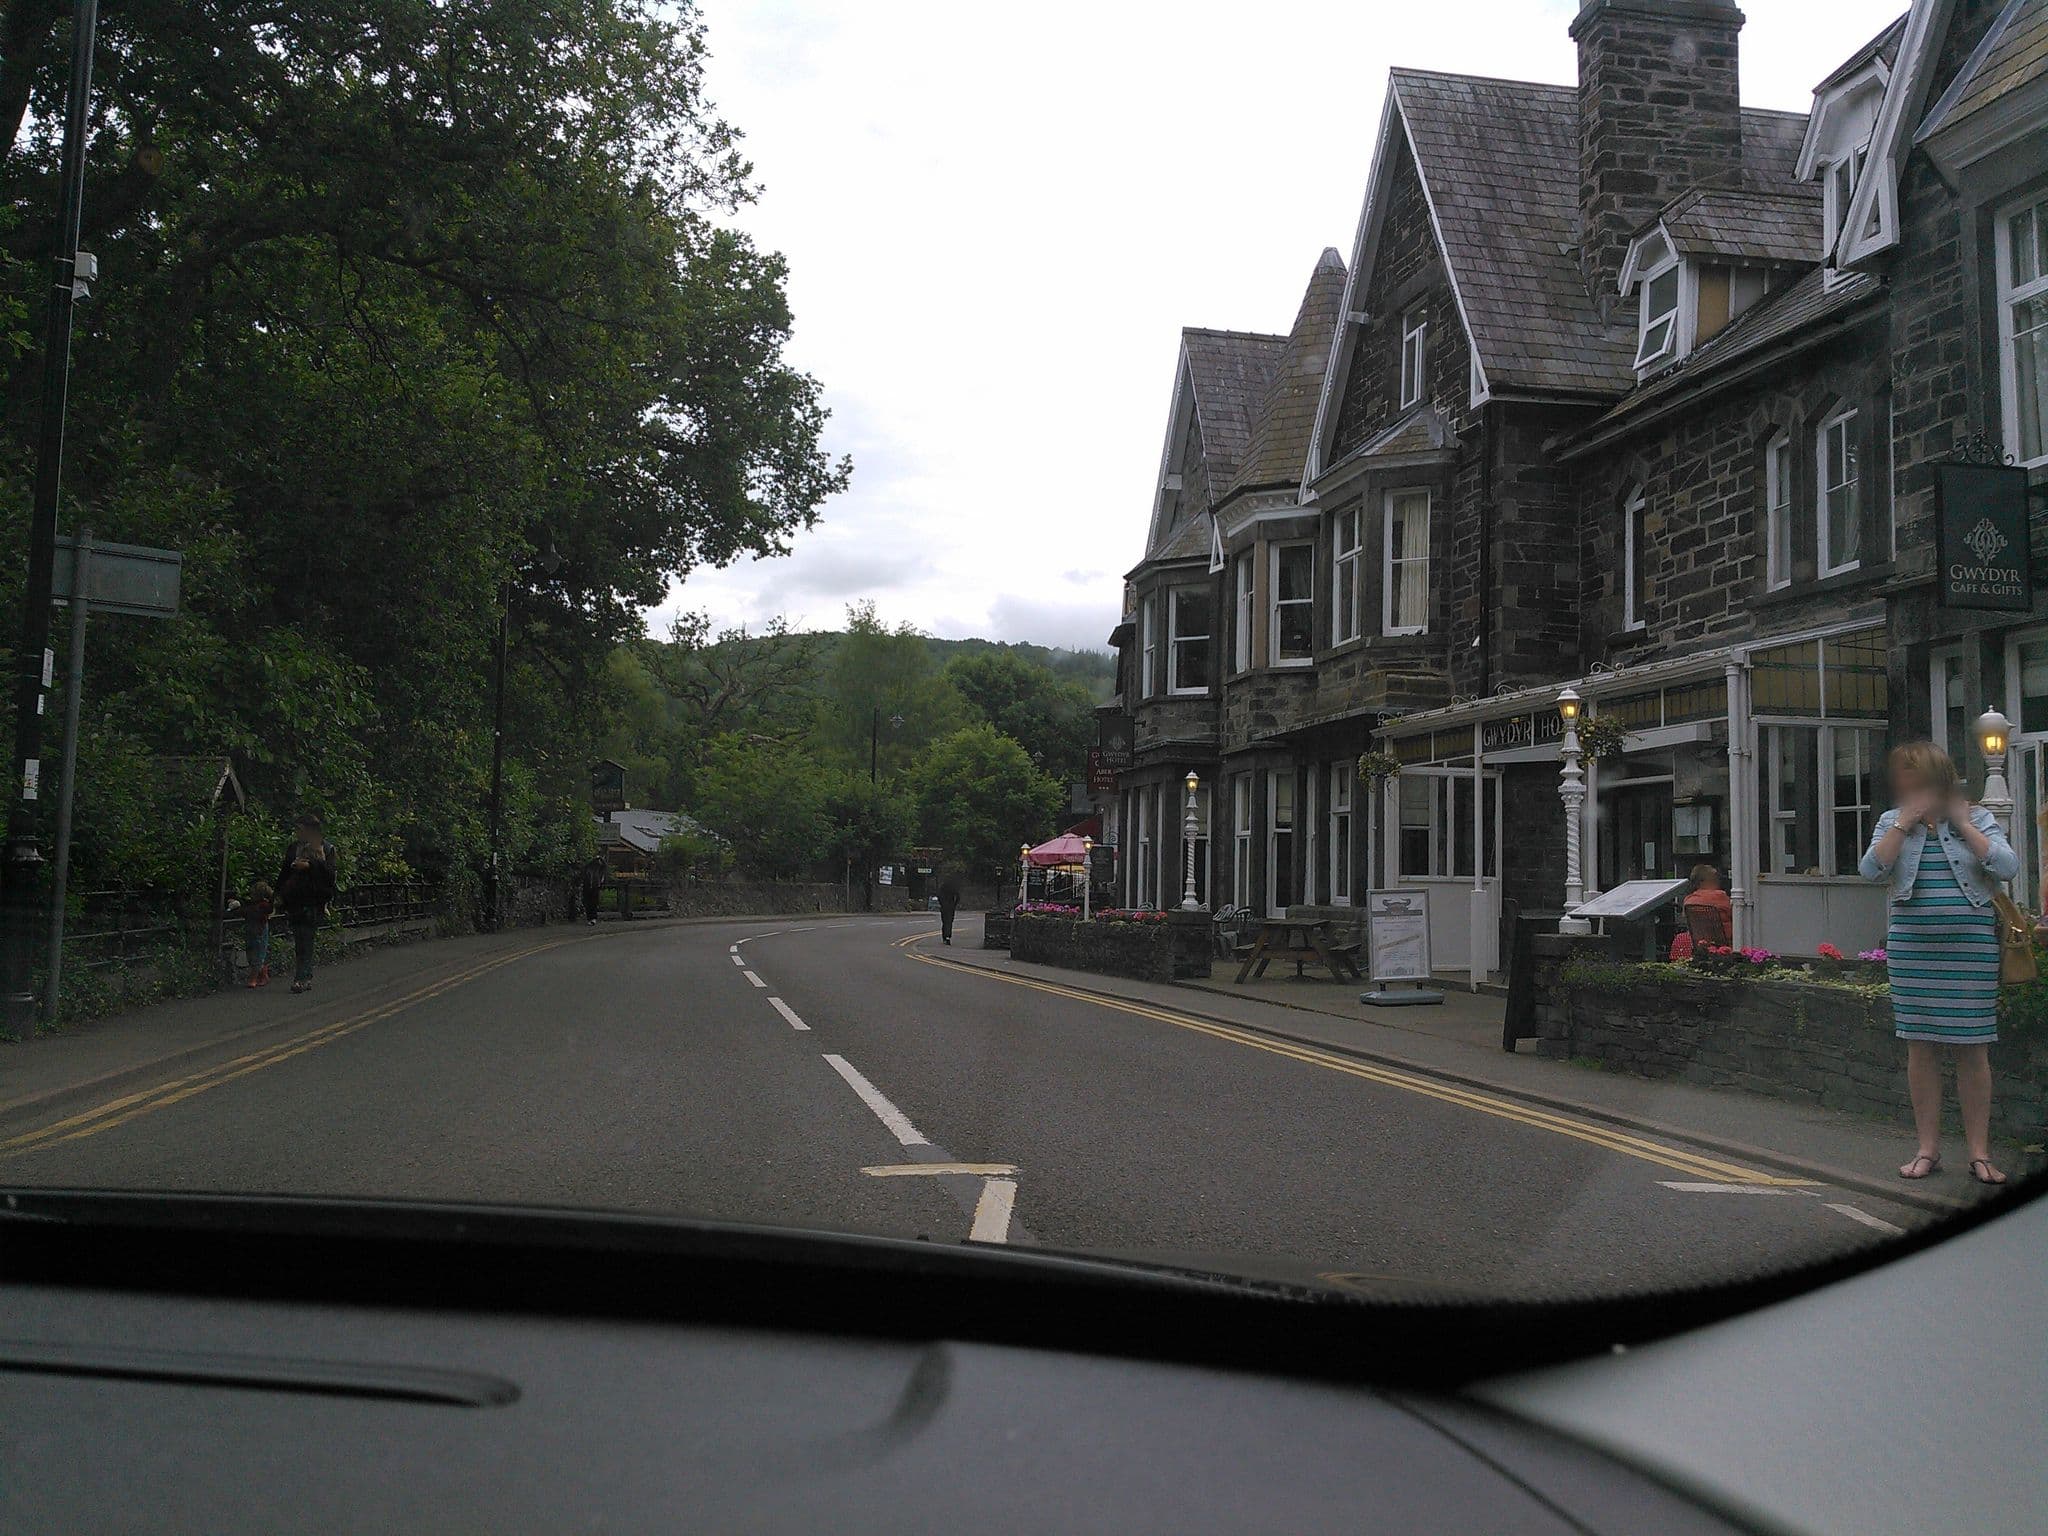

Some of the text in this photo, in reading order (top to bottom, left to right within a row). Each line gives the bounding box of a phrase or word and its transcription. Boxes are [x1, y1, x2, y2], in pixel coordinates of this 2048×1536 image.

[1950, 564, 2021, 583] GWYDYR
[1951, 582, 2023, 595] CAFE & GIFTS
[1483, 720, 1530, 746] GWYDYR
